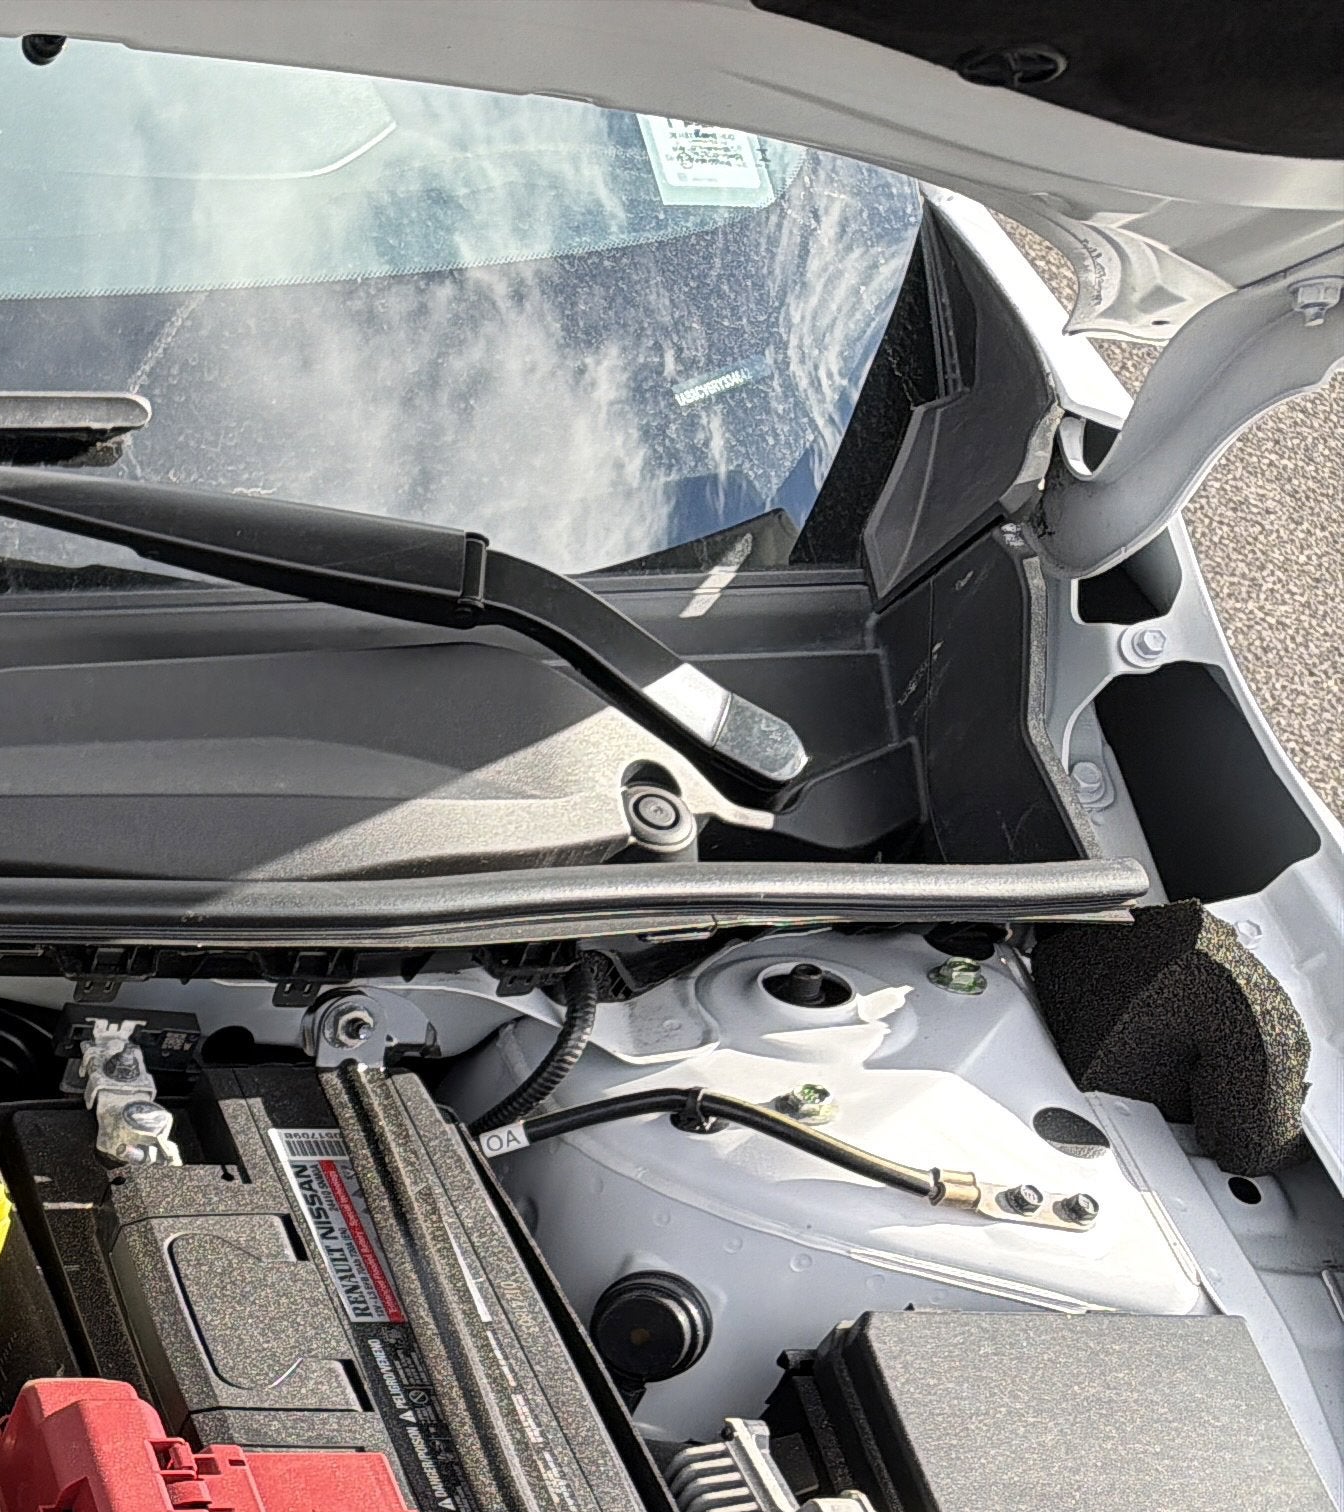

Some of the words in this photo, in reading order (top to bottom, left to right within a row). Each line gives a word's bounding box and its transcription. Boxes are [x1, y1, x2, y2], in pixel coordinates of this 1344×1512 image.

[486, 1127, 522, 1152] OA
[290, 1164, 338, 1239] NISSAN
[323, 1245, 373, 1317] RENAULT
